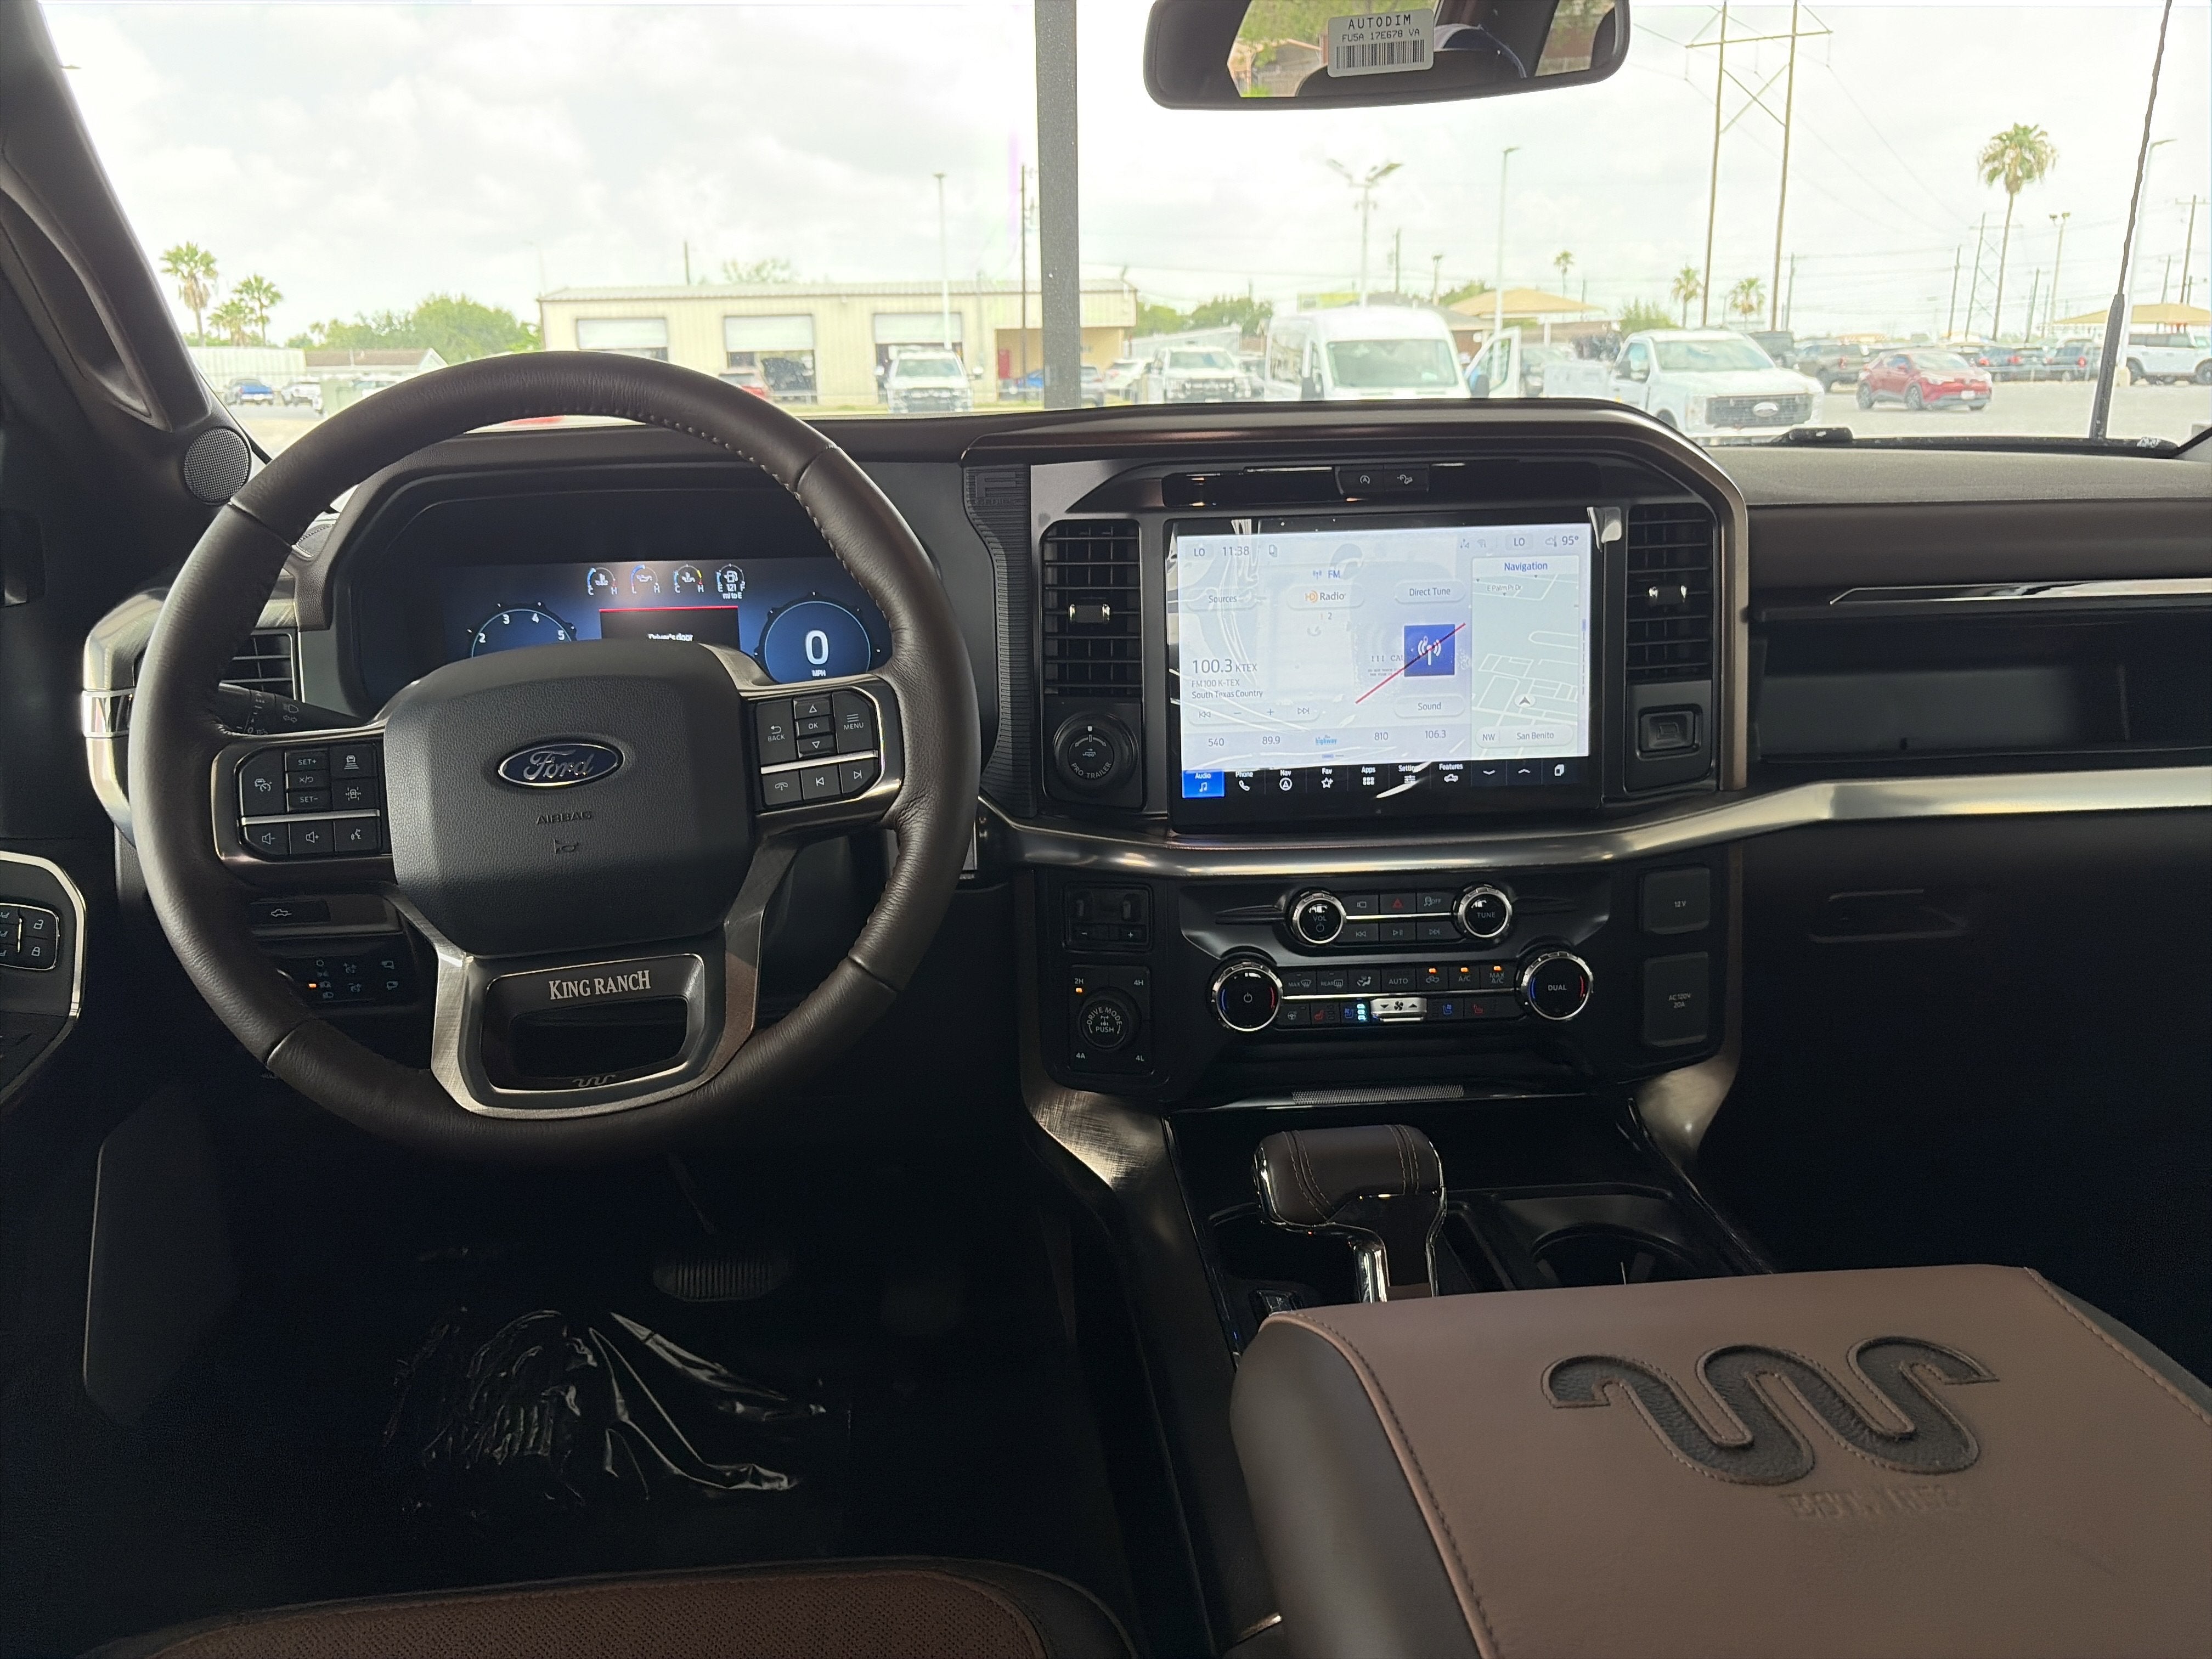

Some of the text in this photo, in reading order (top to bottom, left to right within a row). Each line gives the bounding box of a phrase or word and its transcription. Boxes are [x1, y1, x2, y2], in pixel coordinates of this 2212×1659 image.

[1348, 14, 1412, 30] AUTODIM
[1342, 29, 1420, 42] FU5A 17E678 VA
[1514, 538, 1525, 546] LO
[1562, 536, 1579, 545] 95°
[1194, 548, 1205, 557] LO
[1222, 546, 1249, 556] 11:38
[1504, 562, 1548, 572] Navigation
[588, 587, 594, 596] C
[1319, 592, 1345, 601] Radio
[1409, 588, 1430, 596] Direct
[1209, 595, 1237, 603] Sources
[503, 614, 510, 624] 3
[532, 613, 539, 623] 4
[478, 633, 486, 643] 2
[557, 630, 565, 640] 5
[805, 629, 830, 665] 0
[1193, 659, 1257, 674] 100.3 KTEX
[1235, 690, 1263, 698] Country
[1418, 702, 1441, 710] Sound
[1425, 730, 1446, 738] 106.3
[1208, 738, 1224, 747] 540
[1262, 736, 1280, 744] 89.9
[523, 749, 595, 781] Ford
[1071, 761, 1111, 778] PRO TRAILER
[1361, 766, 1376, 775] Apps
[537, 811, 592, 825] AIRBAG
[549, 970, 651, 1000] KING RANCH
[1086, 1007, 1122, 1025] DRIVE MODE
